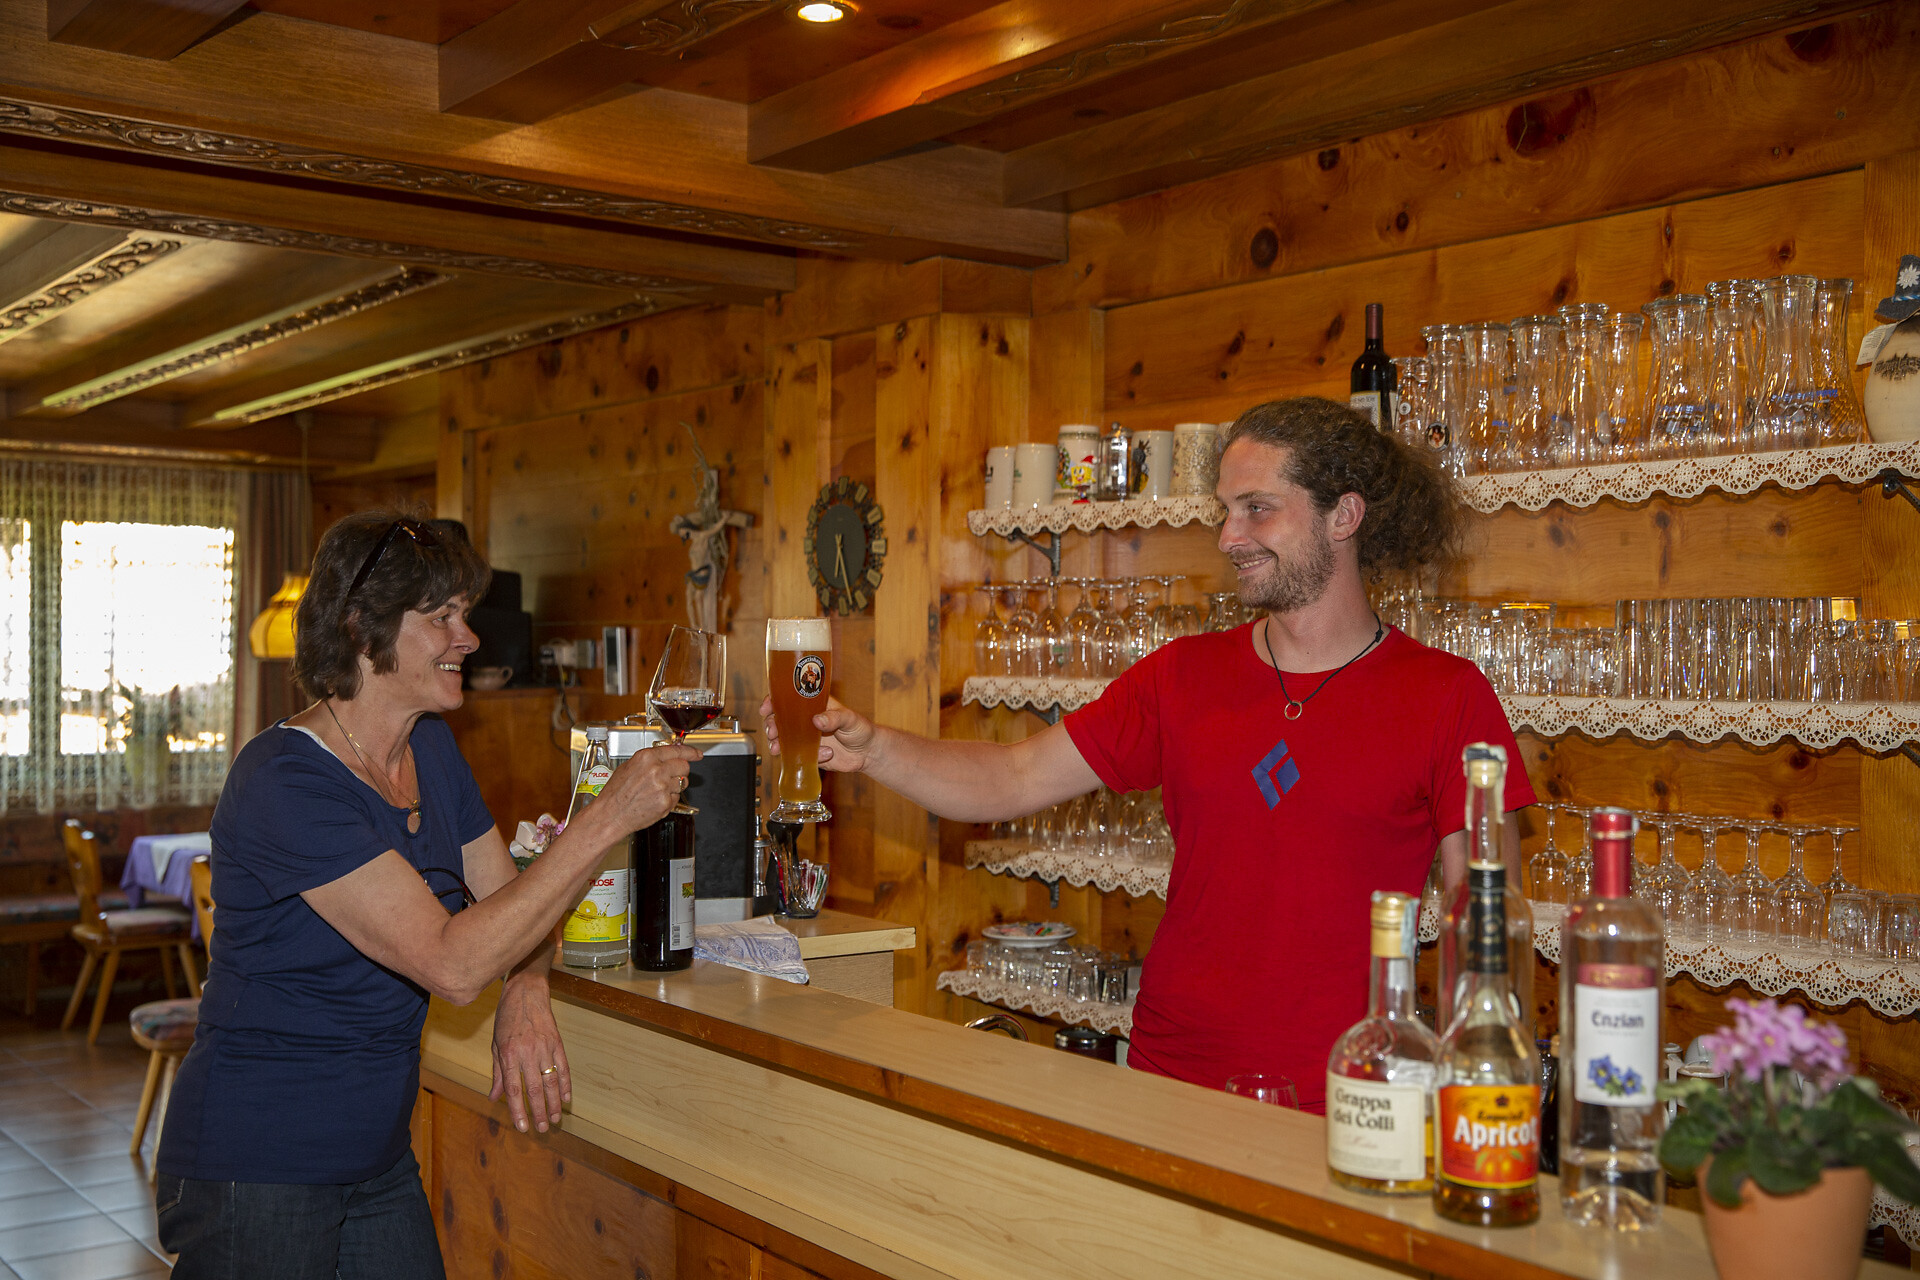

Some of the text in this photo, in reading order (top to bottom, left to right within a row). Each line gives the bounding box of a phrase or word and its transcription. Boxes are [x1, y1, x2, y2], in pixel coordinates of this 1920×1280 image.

[1592, 1010, 1644, 1028] Enzian
[1335, 1087, 1391, 1111] Grappa
[1356, 1111, 1395, 1130] Colli
[1453, 1114, 1537, 1151] Apricot
